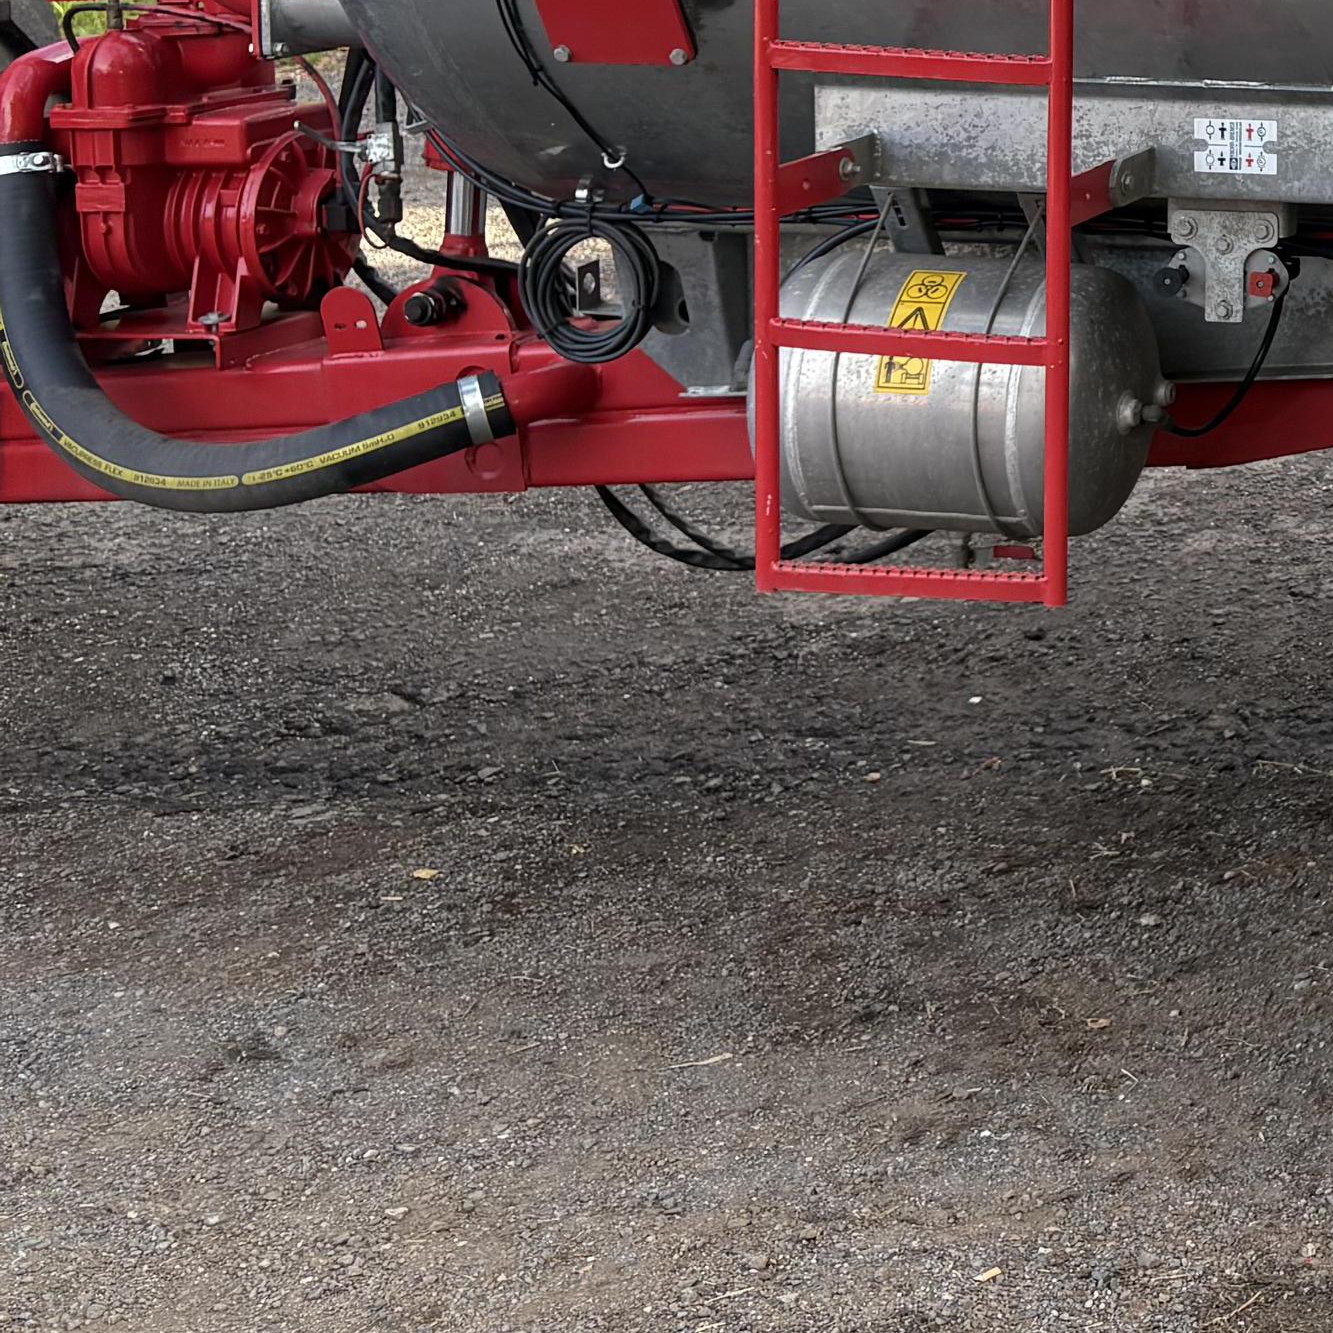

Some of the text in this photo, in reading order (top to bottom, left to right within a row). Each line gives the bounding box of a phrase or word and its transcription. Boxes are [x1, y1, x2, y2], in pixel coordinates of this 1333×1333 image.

[319, 445, 361, 465] VACUUM
[176, 477, 201, 488] MADE
[202, 477, 213, 487] IN
[214, 476, 236, 487] ITALY
